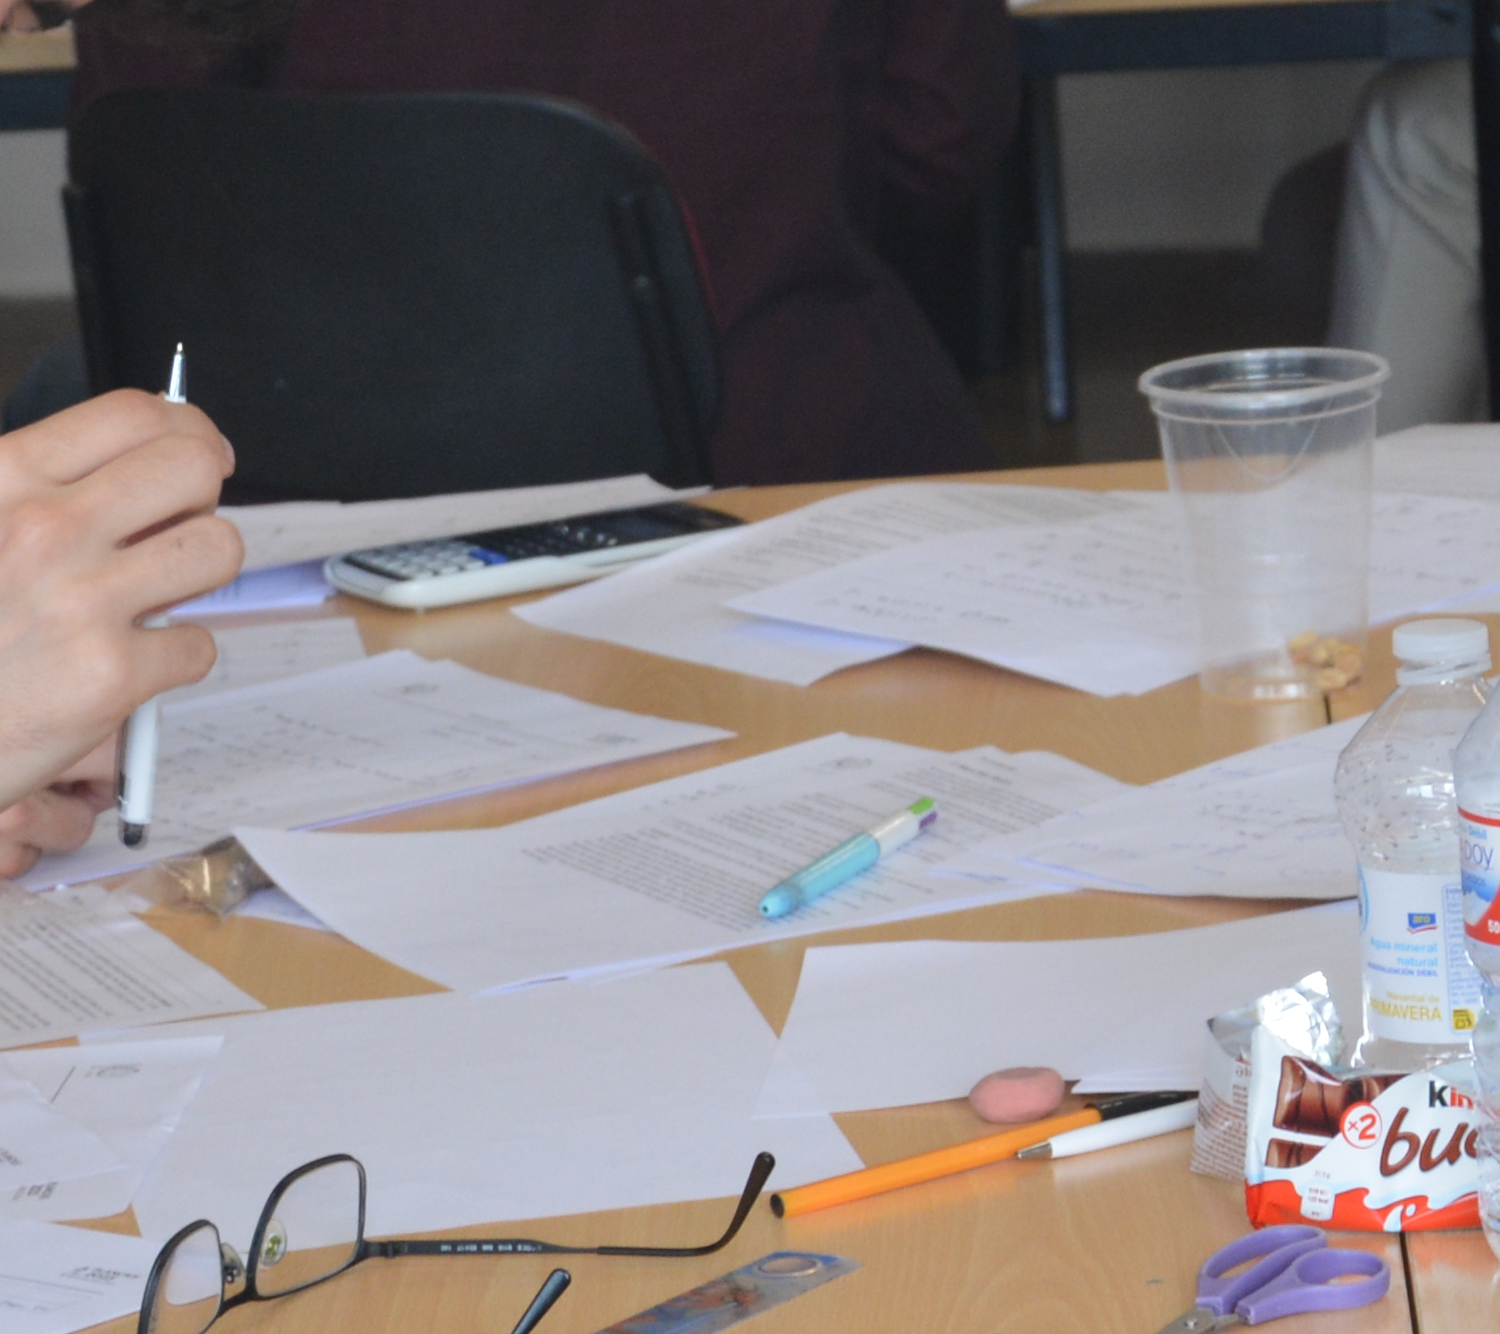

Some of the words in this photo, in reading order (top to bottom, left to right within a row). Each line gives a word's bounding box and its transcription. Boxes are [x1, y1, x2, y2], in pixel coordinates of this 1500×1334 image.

[1393, 942, 1438, 953] mineral
[1397, 956, 1439, 967] natural
[1428, 1080, 1474, 1110] kin
